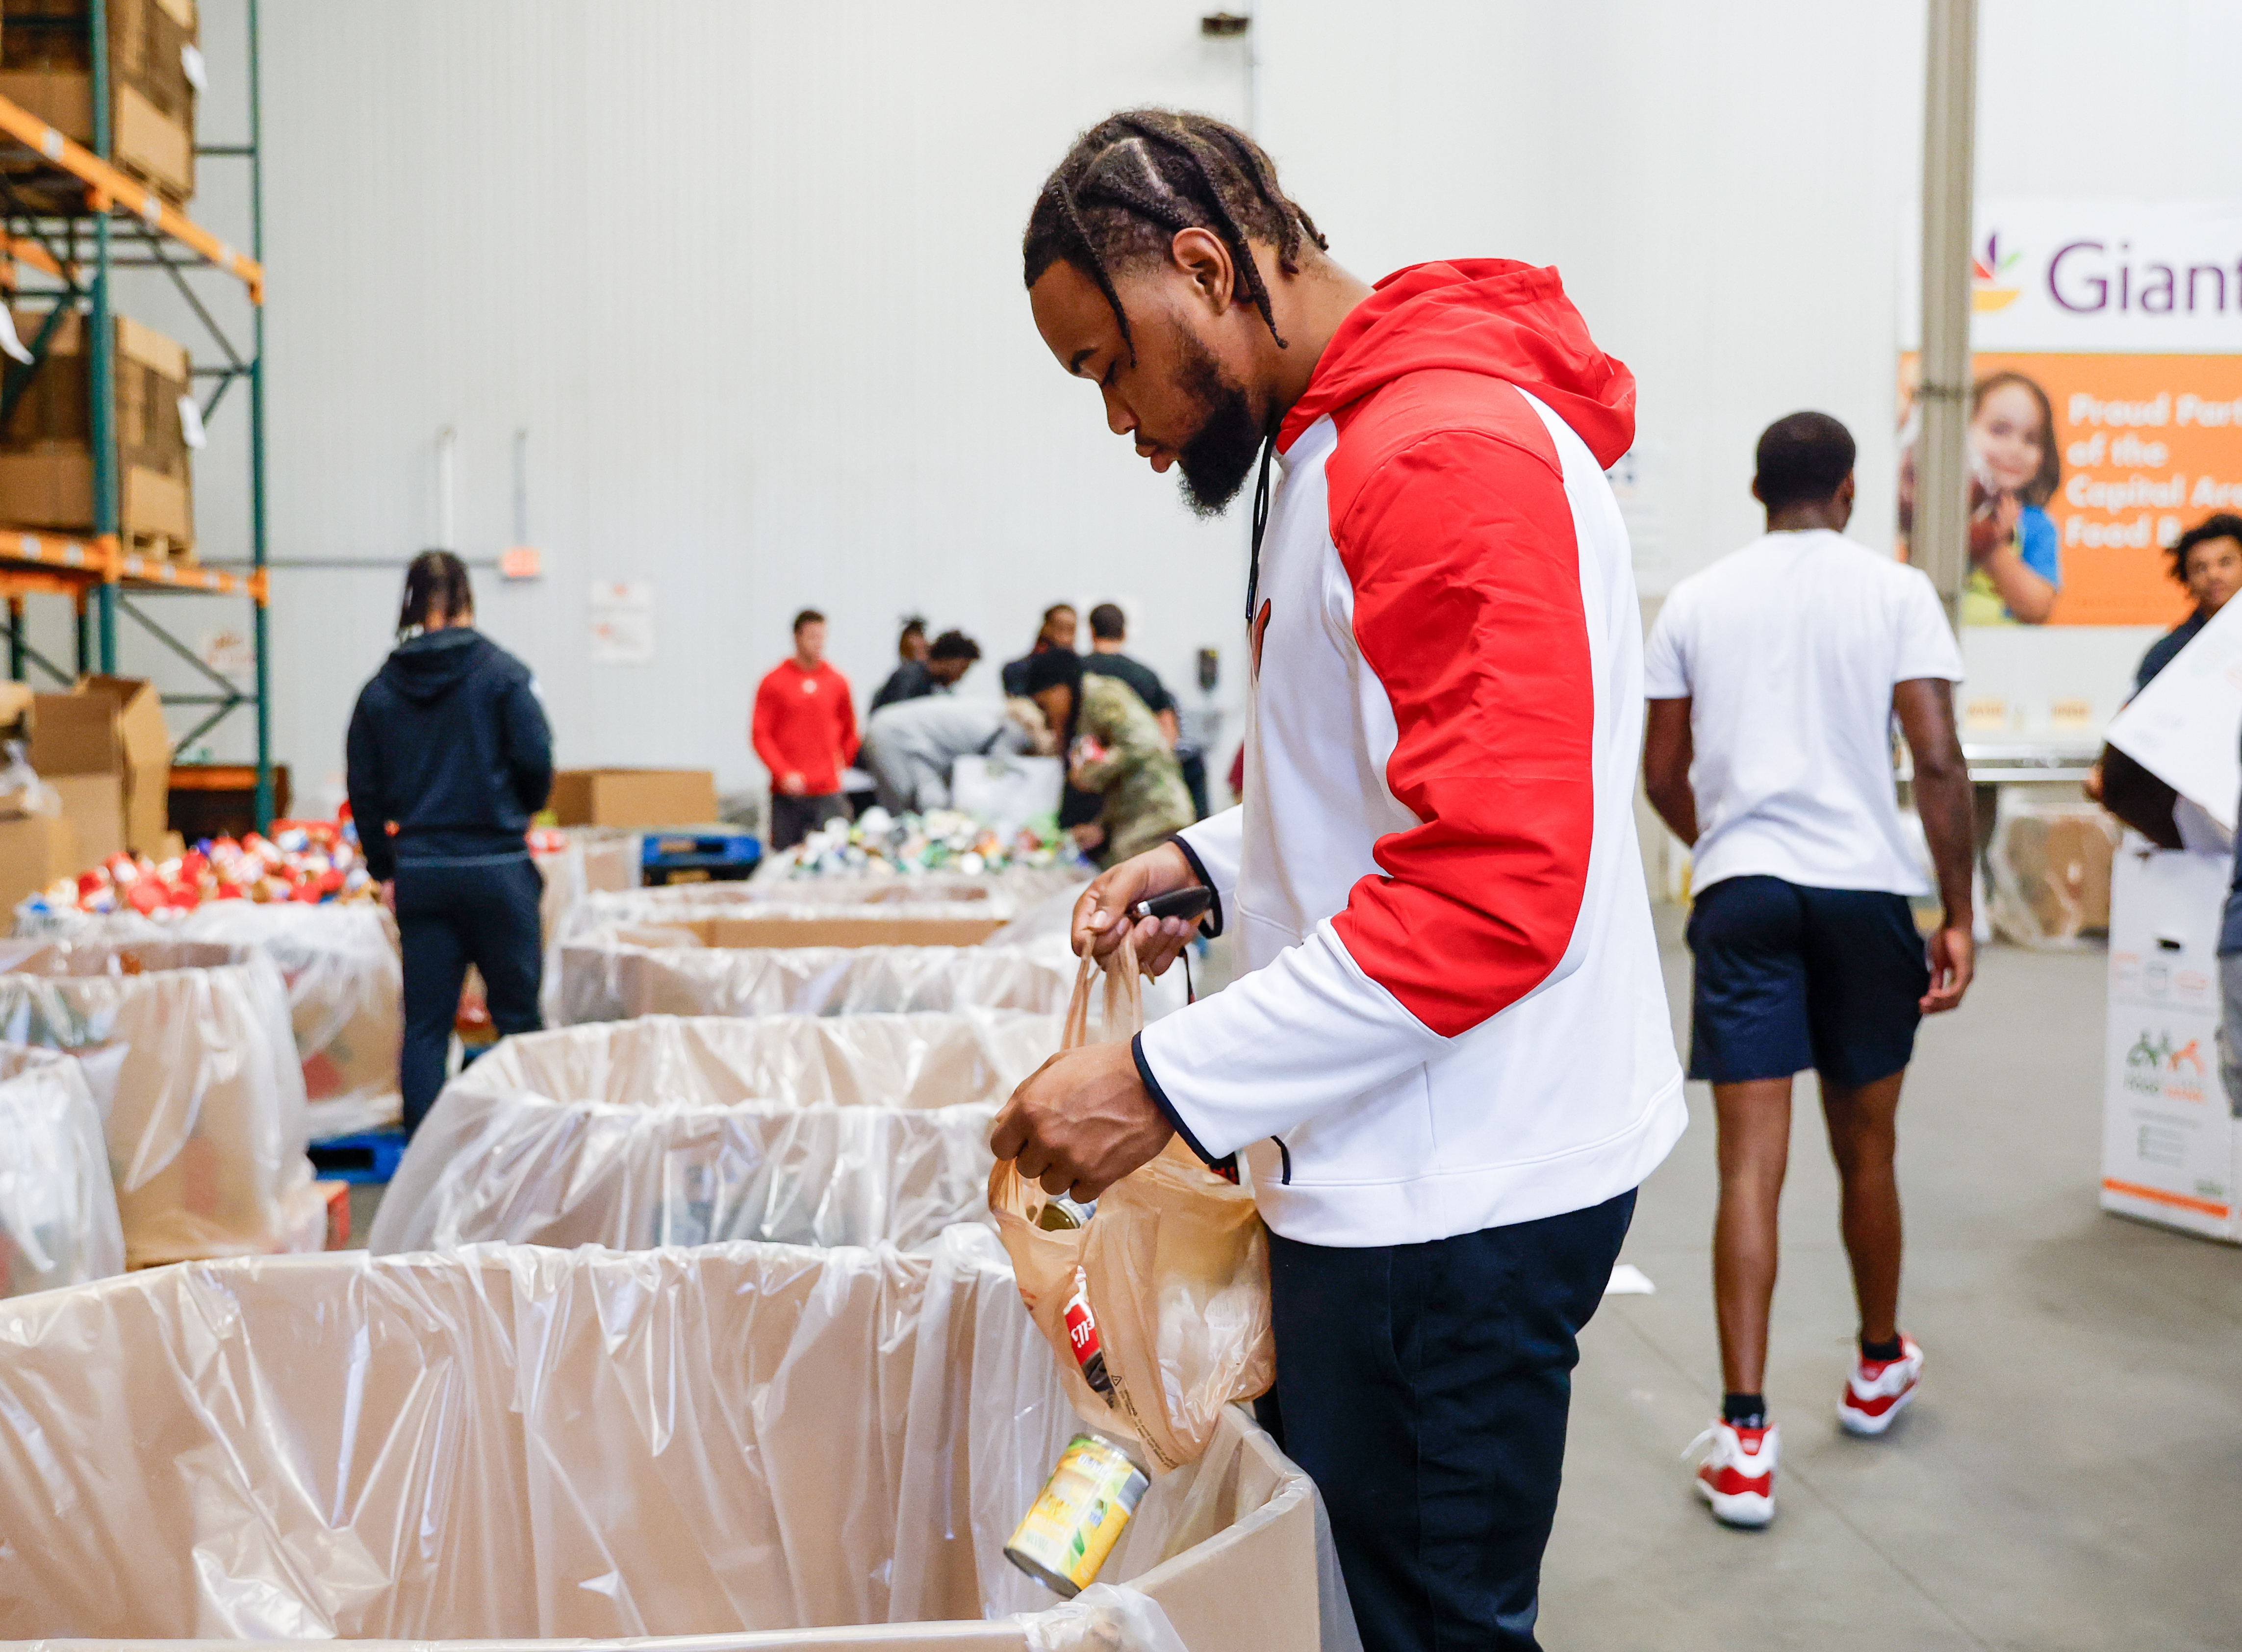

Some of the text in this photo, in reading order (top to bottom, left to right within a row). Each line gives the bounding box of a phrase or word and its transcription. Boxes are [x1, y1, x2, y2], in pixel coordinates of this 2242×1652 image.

[2068, 392, 2171, 427] Proud
[2067, 432, 2168, 467] of the
[2066, 474, 2185, 514] Capital
[2066, 514, 2151, 548] Food
